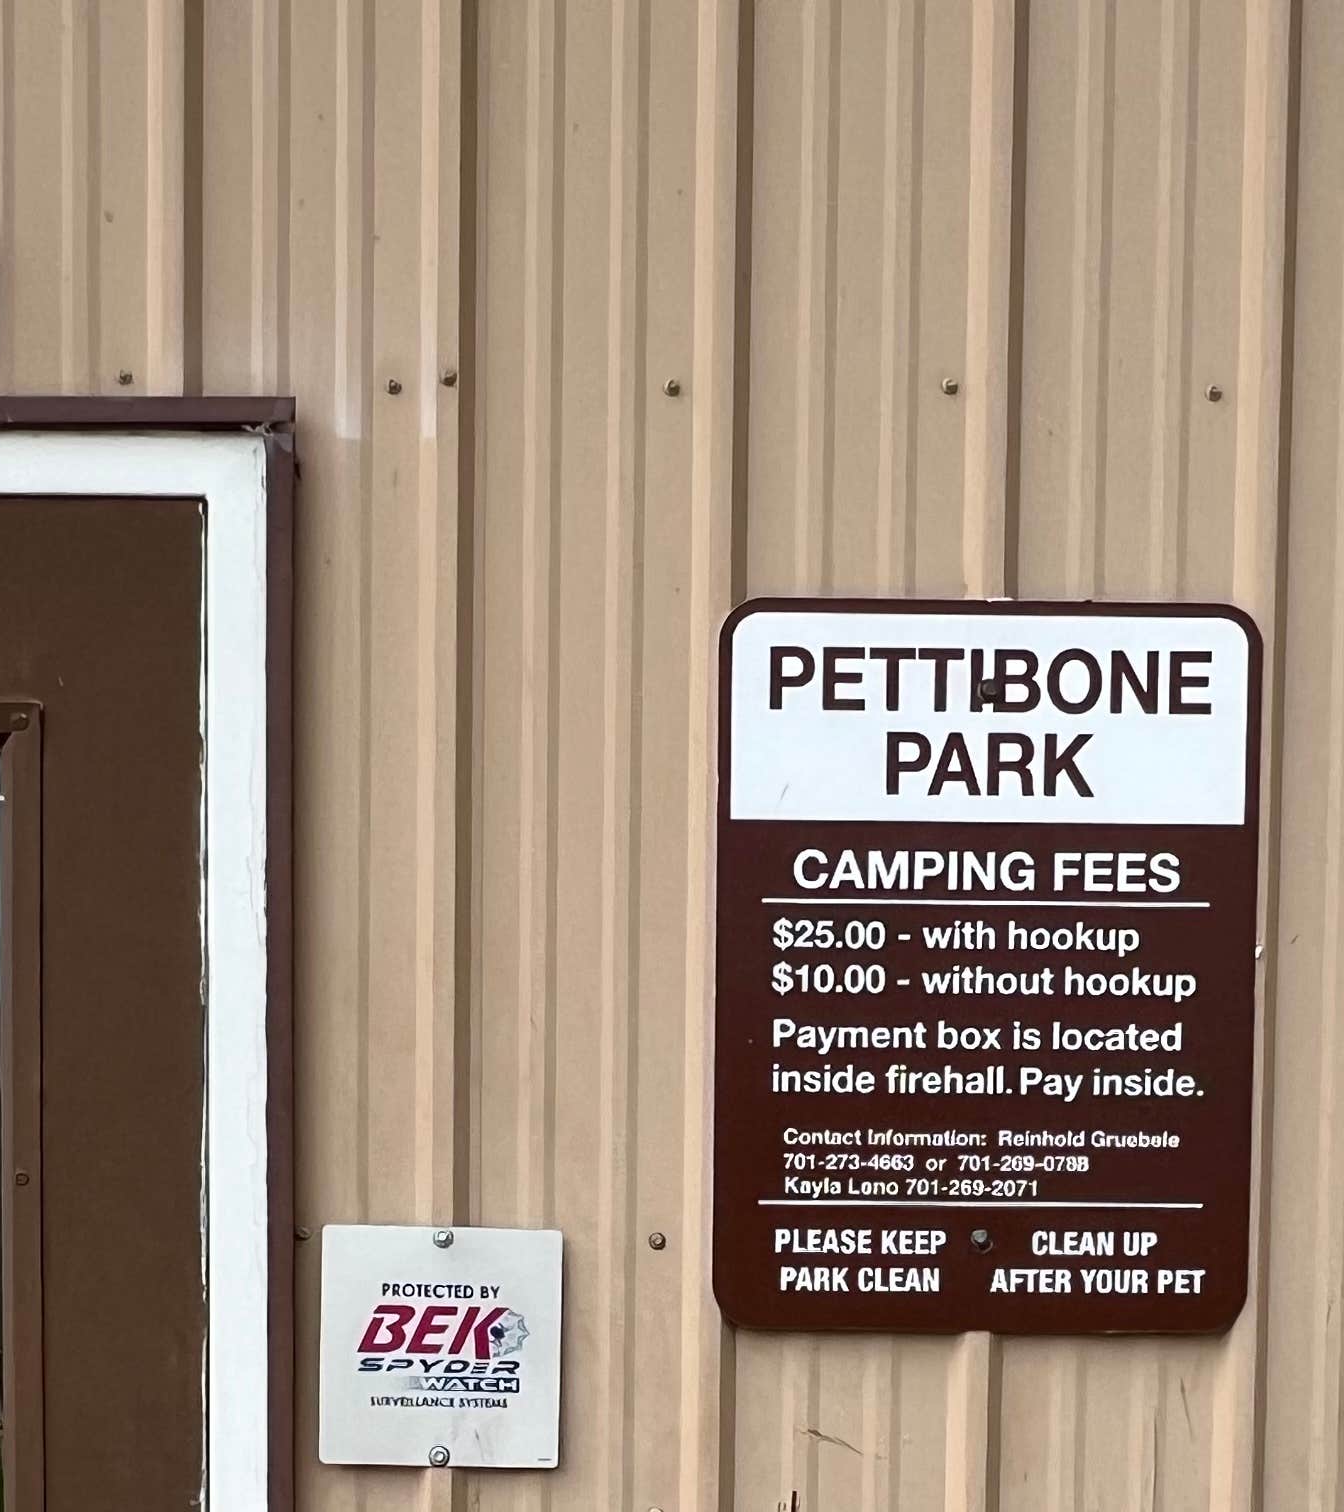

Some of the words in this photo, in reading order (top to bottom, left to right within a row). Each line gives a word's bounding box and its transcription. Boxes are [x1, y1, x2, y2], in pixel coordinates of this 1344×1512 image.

[770, 646, 1212, 714] PETTIBONE
[886, 732, 1094, 797] PARK
[794, 849, 1035, 891] CAMPING
[1054, 853, 1180, 892] FEES
[773, 918, 885, 950] $25.00
[923, 921, 995, 949] with
[1009, 921, 1139, 957] hookup
[772, 961, 885, 995] $10.00
[922, 965, 1054, 995] without
[1065, 966, 1196, 1002] hookup
[774, 1019, 926, 1054] Payment
[938, 1021, 1001, 1049] box
[1013, 1022, 1040, 1049] is
[1053, 1022, 1182, 1051] located
[773, 1064, 875, 1093] inside
[885, 1065, 1012, 1094] firehall.
[1021, 1067, 1083, 1102] Pay
[1093, 1069, 1203, 1096] inside.
[784, 1128, 861, 1145] Contact
[868, 1129, 986, 1146] Information:
[999, 1130, 1085, 1147] Reinhold
[926, 1159, 947, 1171] or
[785, 1177, 841, 1198] Kayla
[906, 1179, 1037, 1196] 701-269-2071
[775, 1229, 871, 1254] PLEASE
[882, 1230, 946, 1254] KEEP
[1032, 1231, 1114, 1256] CLEAN
[1124, 1232, 1157, 1256] UP
[383, 1283, 473, 1298] PROTECTED
[481, 1286, 499, 1298] BY
[781, 1267, 849, 1291] PARK
[858, 1268, 939, 1291] CLEAN
[990, 1269, 1071, 1293] AFTER
[1080, 1269, 1148, 1293] YOUR
[1158, 1270, 1205, 1293] PET
[357, 1305, 508, 1360] BEK
[358, 1357, 519, 1375] SPYDER
[420, 1377, 518, 1391] WATCH
